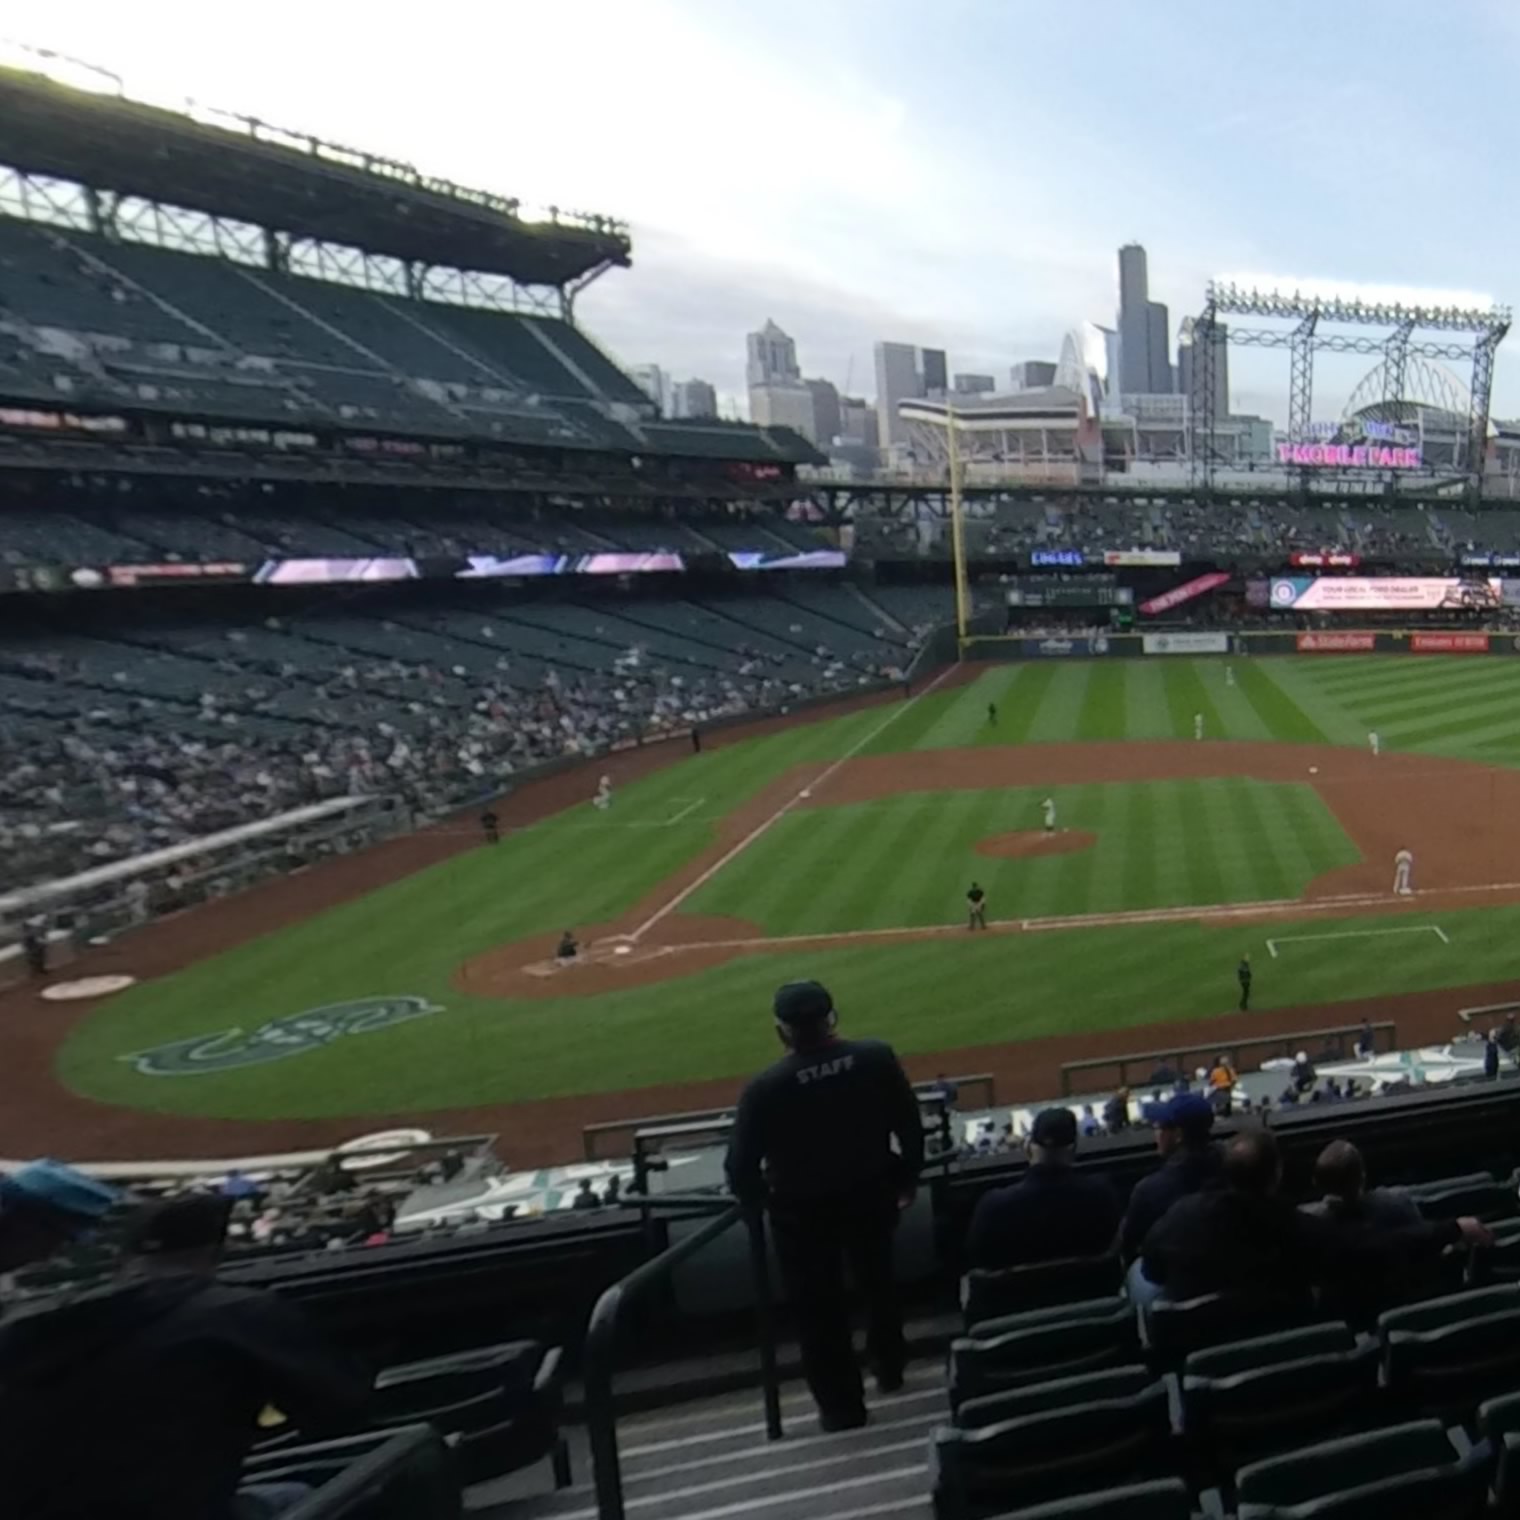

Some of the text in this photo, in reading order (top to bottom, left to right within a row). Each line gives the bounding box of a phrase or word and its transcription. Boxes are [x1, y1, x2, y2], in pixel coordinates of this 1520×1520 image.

[1278, 442, 1418, 468] T-MOBILE PARK
[796, 1054, 854, 1085] STAFF
